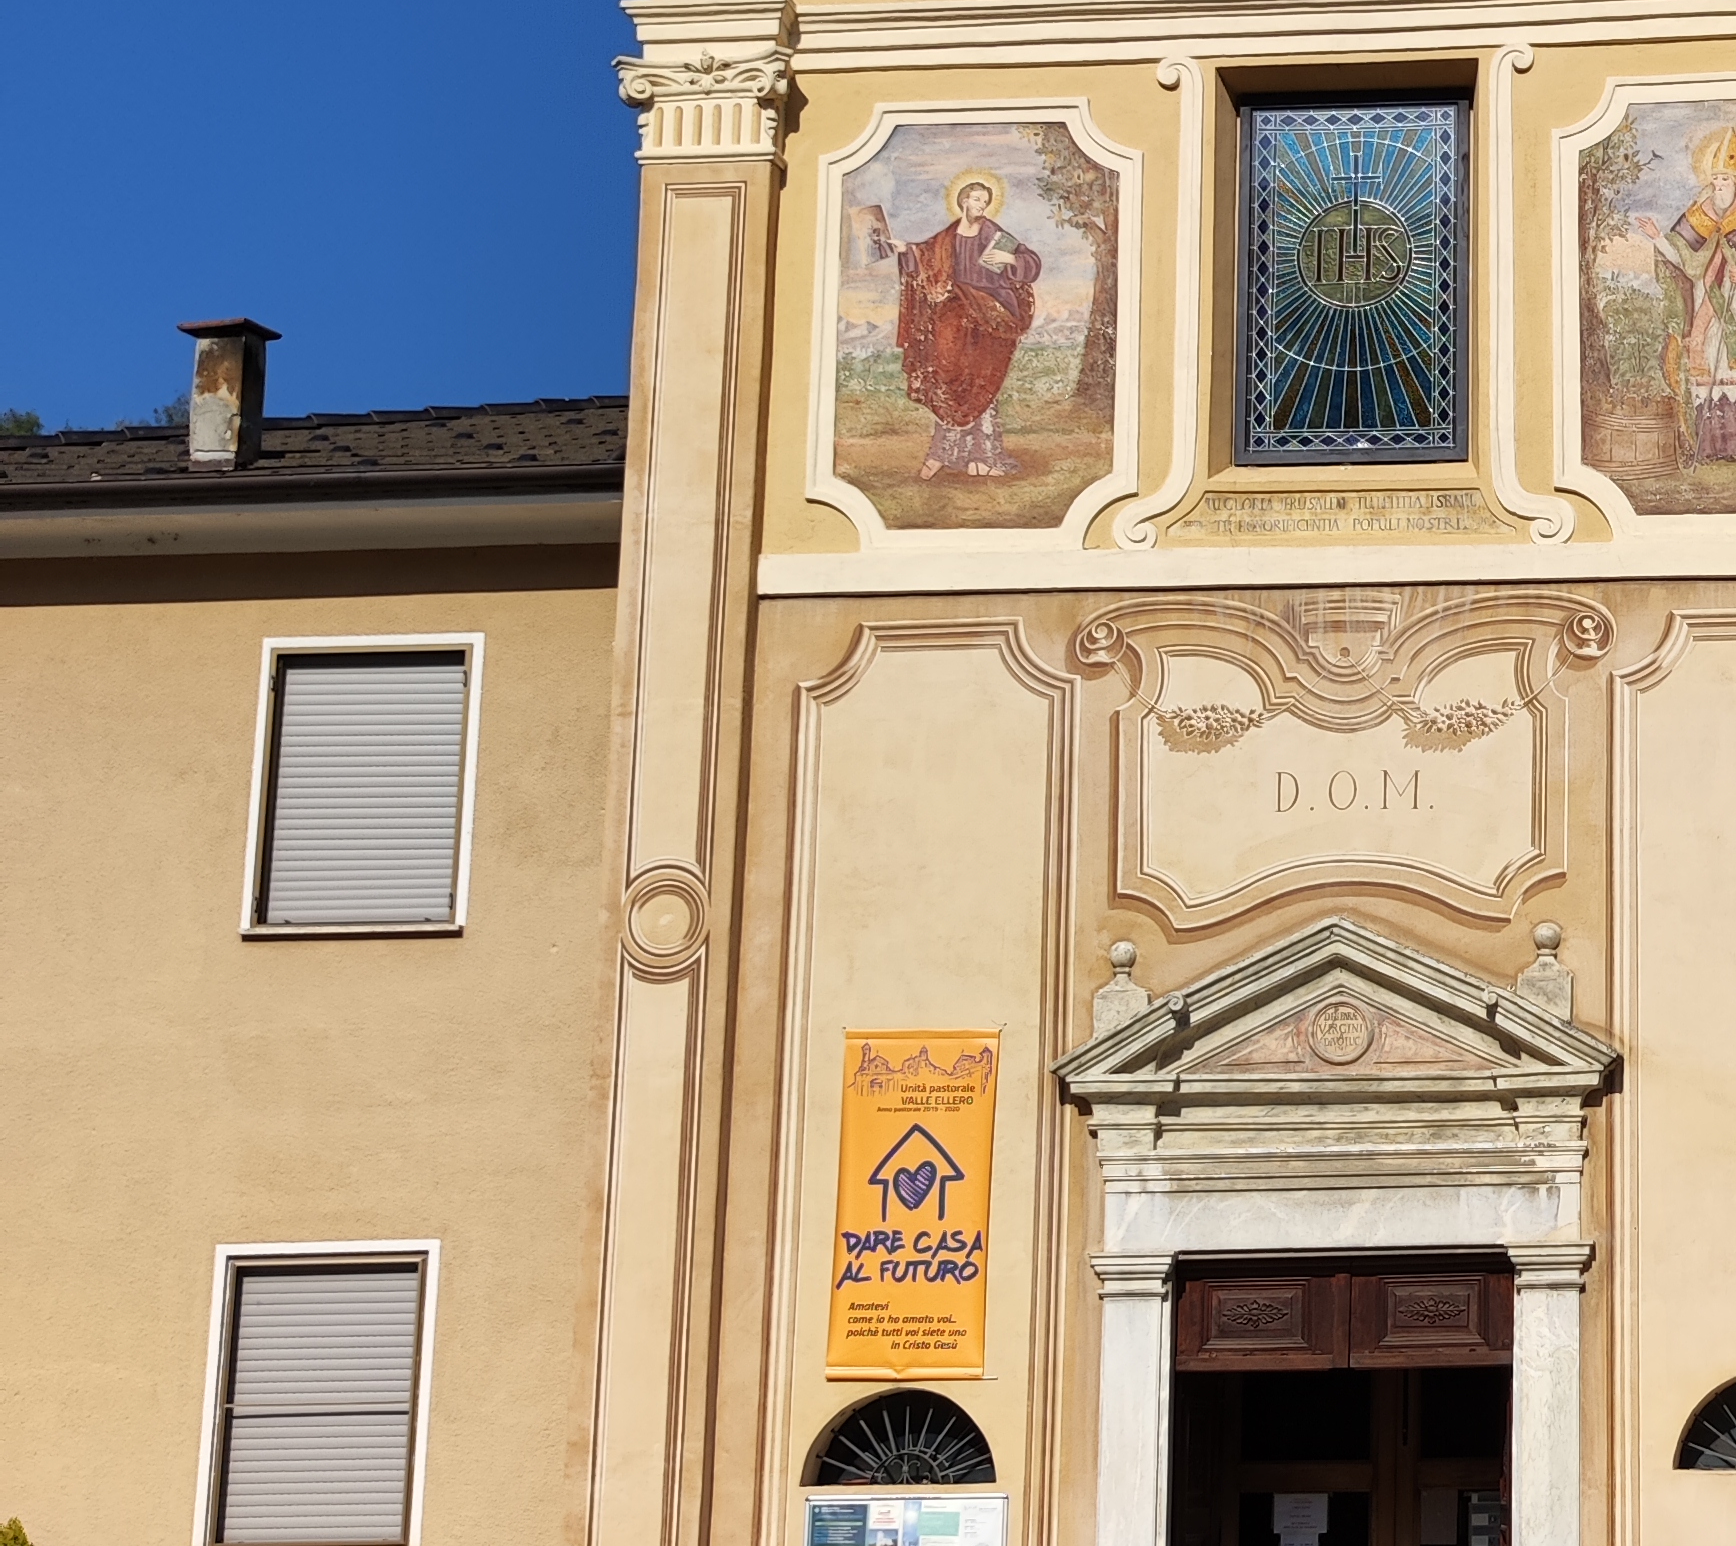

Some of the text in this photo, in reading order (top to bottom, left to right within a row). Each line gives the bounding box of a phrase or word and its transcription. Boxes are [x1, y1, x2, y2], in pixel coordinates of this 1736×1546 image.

[1311, 226, 1402, 284] IHS
[901, 1083, 976, 1094] Unità pastorale
[901, 1096, 974, 1105] VALLE ELLERO
[841, 1229, 983, 1261] DARE CASA
[836, 1259, 980, 1291] AL FUTURO
[848, 1301, 890, 1311] Amatevi
[848, 1316, 874, 1324] come
[887, 1314, 900, 1324] ho
[902, 1315, 934, 1324] amato
[881, 1327, 903, 1337] tutti
[905, 1327, 920, 1337] voi
[921, 1327, 945, 1337] siete
[947, 1329, 967, 1337] uno
[891, 1340, 900, 1349] in
[903, 1340, 931, 1350] Cristo
